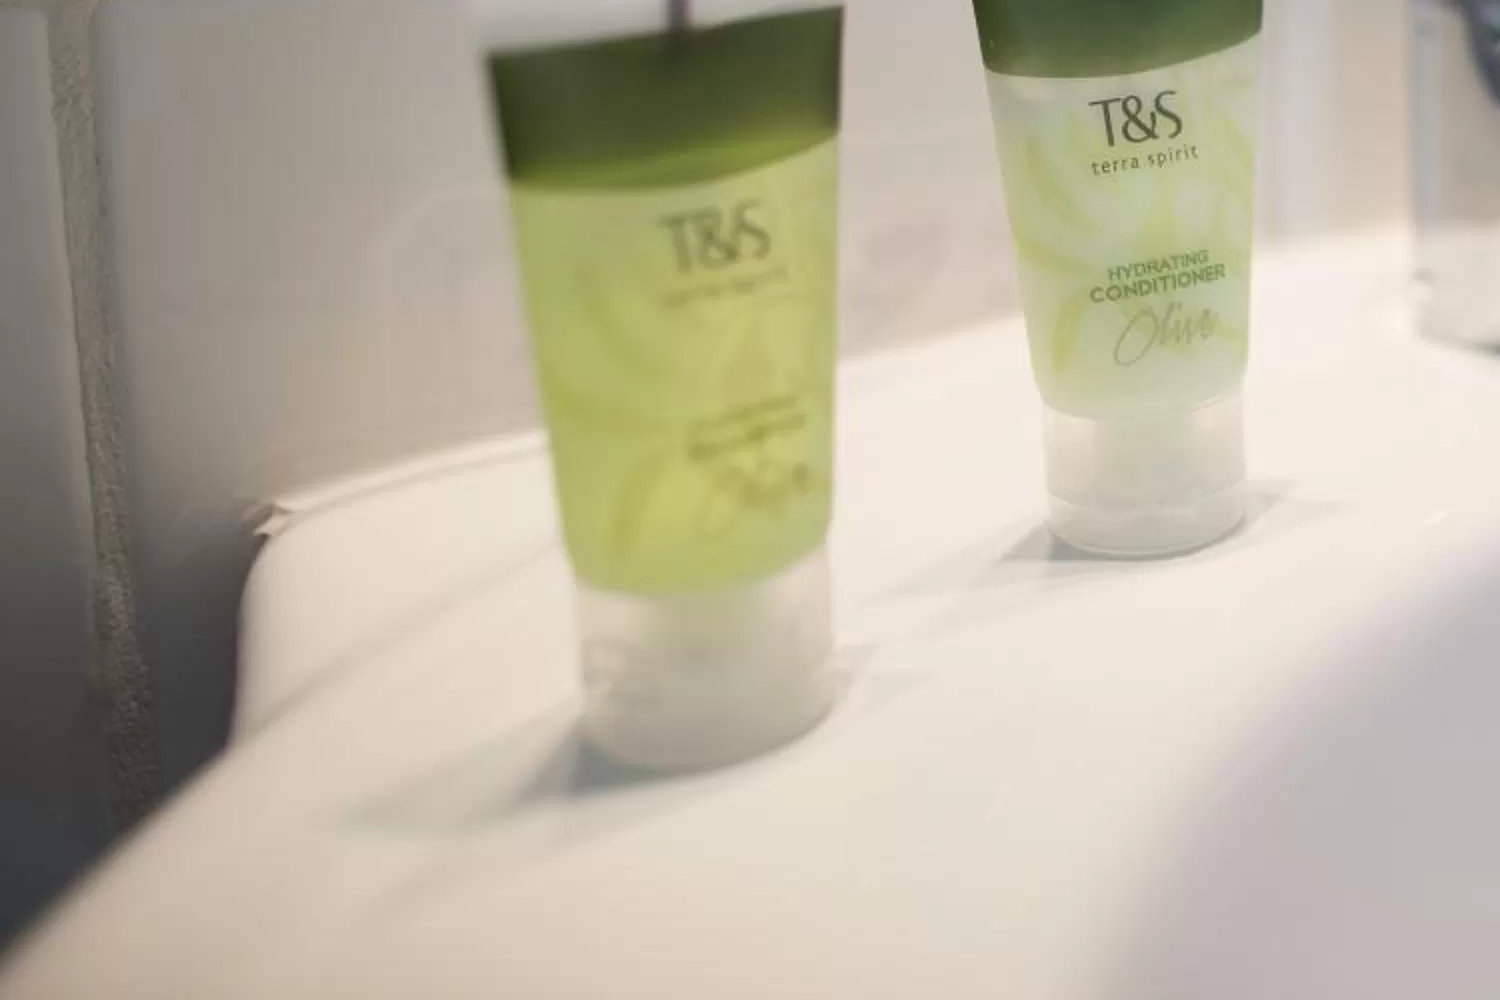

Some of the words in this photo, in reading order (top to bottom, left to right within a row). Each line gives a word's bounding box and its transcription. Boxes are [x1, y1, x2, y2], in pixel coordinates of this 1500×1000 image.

[1088, 90, 1183, 147] T&S
[1091, 153, 1140, 175] terra
[1147, 144, 1199, 170] spirit
[657, 200, 771, 275] T&S
[1089, 263, 1227, 304] CONDITIONER
[1107, 250, 1210, 281] HYDRATING
[1113, 301, 1219, 367] Olive
